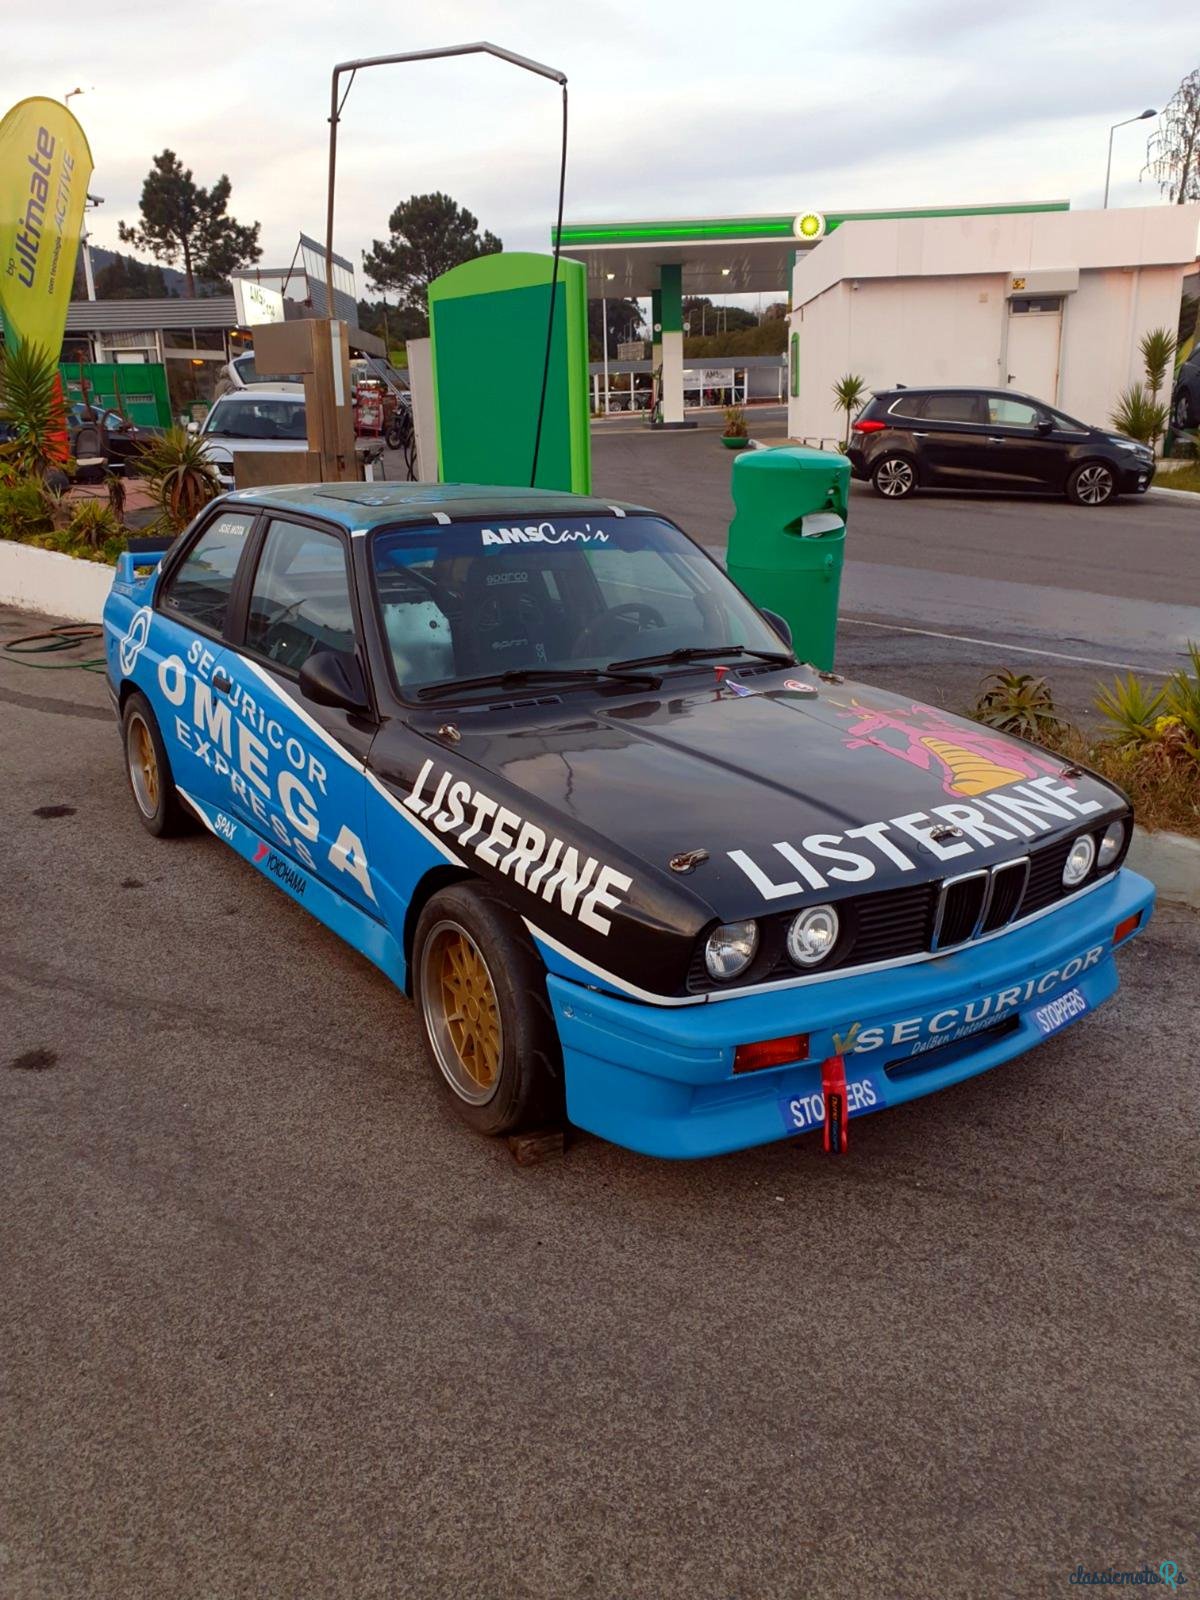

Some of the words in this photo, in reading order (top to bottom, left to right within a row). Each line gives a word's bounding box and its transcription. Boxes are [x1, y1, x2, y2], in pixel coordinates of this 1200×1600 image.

[15, 126, 56, 289] ultimate
[55, 149, 75, 235] ACTIVE
[7, 257, 17, 277] bp
[158, 655, 380, 909] OMEGA
[175, 715, 318, 871] EXPRESS
[214, 812, 238, 841] SPAX
[403, 758, 634, 937] LISTERINE
[727, 776, 1103, 900] LISTERINE
[266, 852, 307, 897] YOKOHAMA
[853, 946, 1104, 1054] SECURICOR
[952, 1008, 1011, 1041] Motorsport
[1035, 988, 1087, 1033] STOPPERS
[790, 1079, 877, 1128] STOERS
